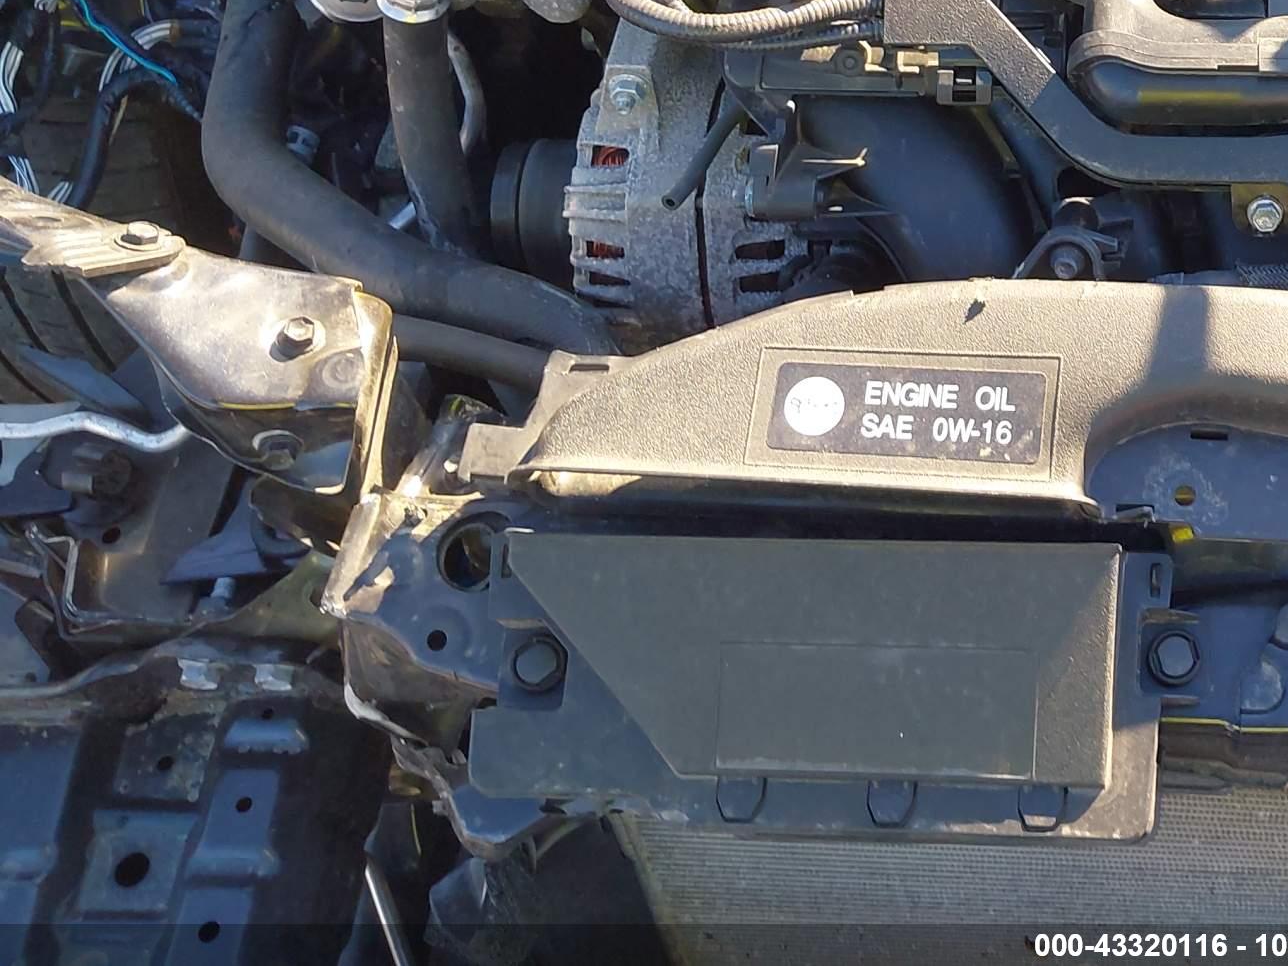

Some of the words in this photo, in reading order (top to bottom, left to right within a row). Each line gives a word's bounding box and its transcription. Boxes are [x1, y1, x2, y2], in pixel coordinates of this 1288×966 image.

[864, 380, 959, 409] ENGINE
[974, 385, 1016, 412] OIL
[860, 413, 914, 440] SAE
[932, 416, 1013, 445] 0W-16
